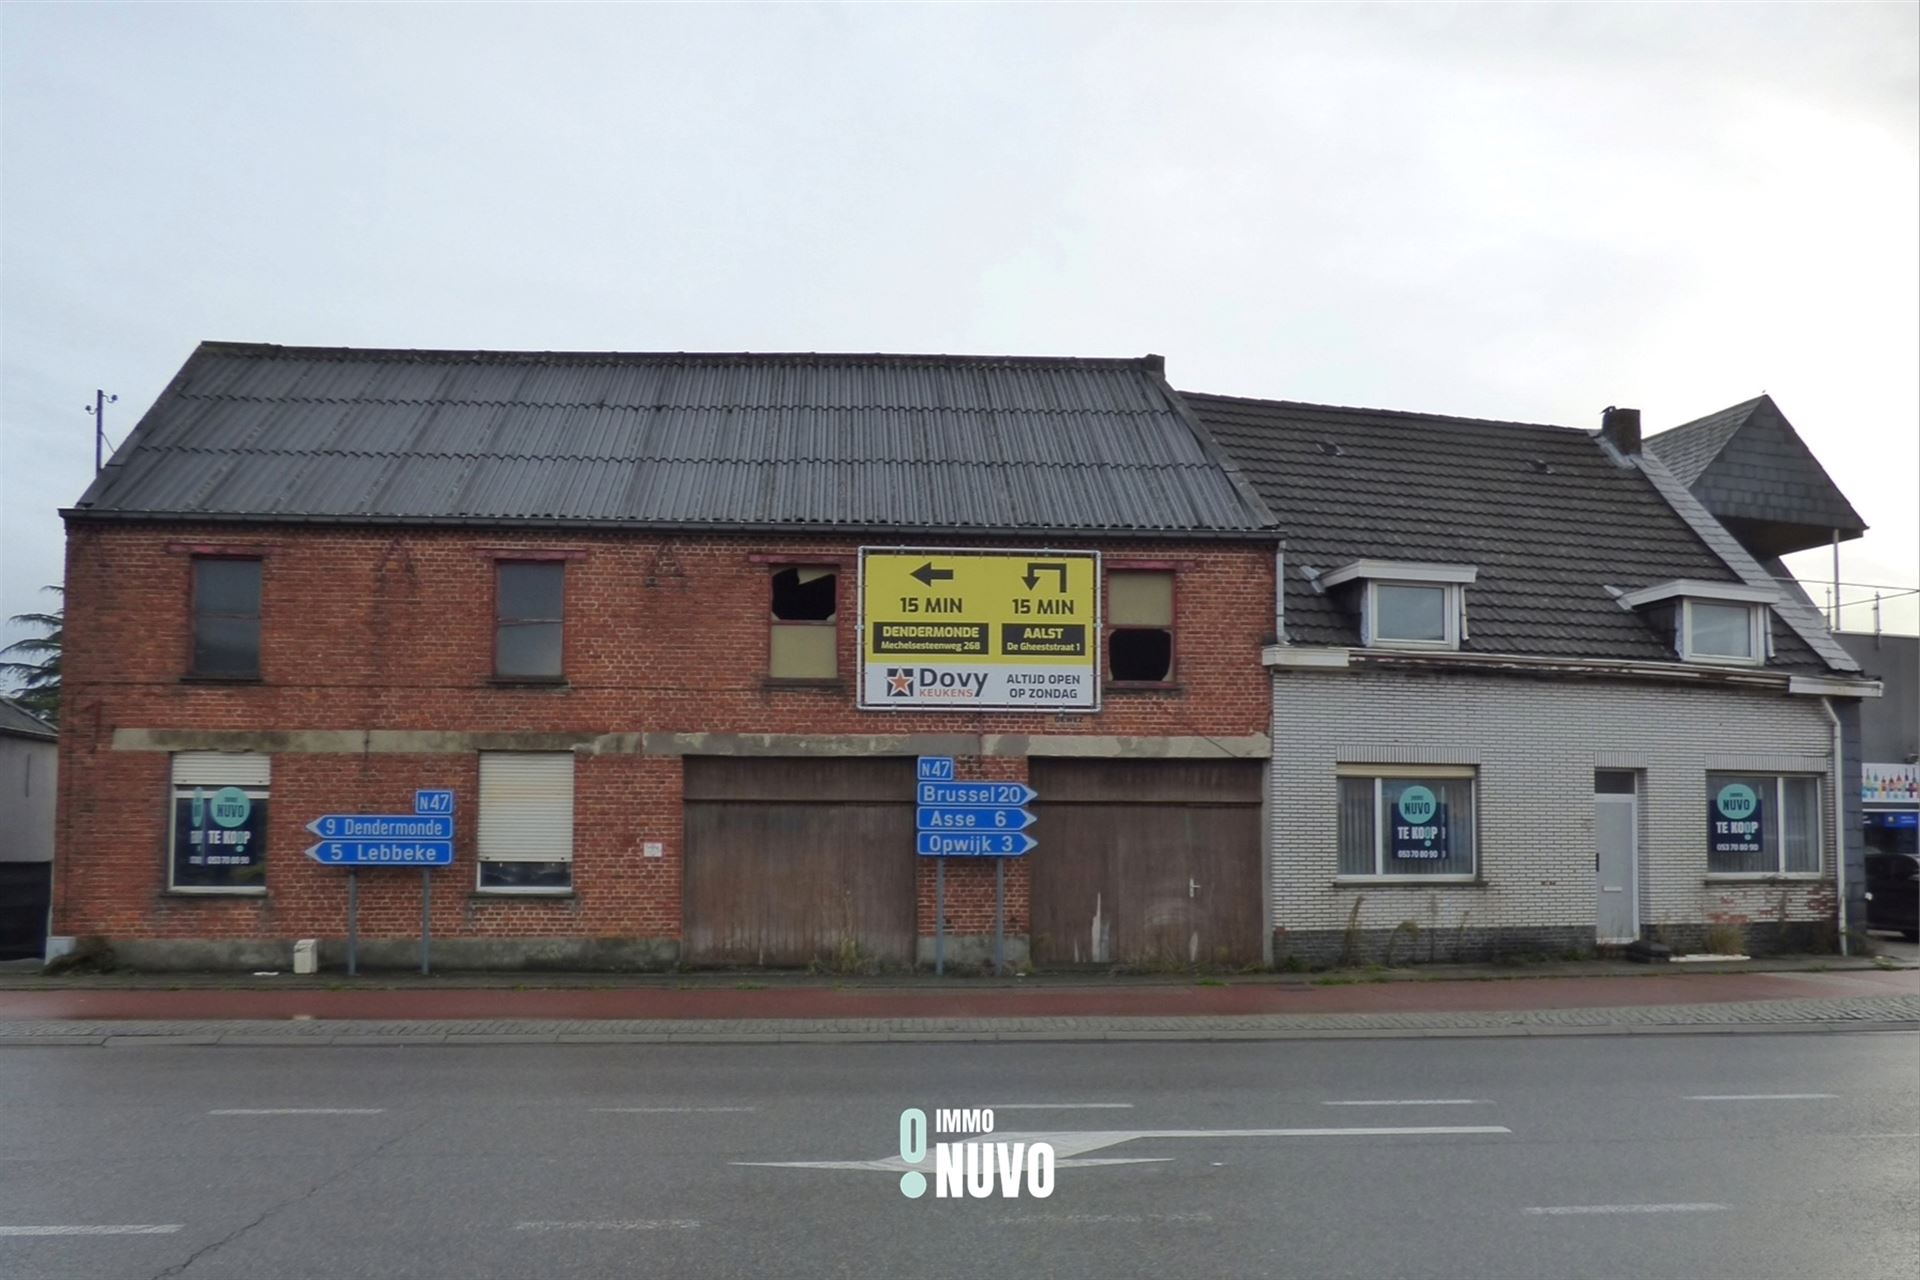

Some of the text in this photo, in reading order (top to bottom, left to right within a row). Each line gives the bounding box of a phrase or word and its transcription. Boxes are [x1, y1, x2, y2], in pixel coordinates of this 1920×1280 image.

[900, 597, 963, 613] 15 MIN
[1012, 599, 1074, 615] 15 MIN
[882, 626, 979, 638] DENDERMONDE
[1024, 628, 1064, 639] AALST
[881, 641, 980, 652] Mechelsesteenweg 268
[1007, 642, 1080, 651] De Gheeststraat 1
[919, 668, 989, 697] Dovy
[1006, 674, 1081, 685] ALTIJD OPEN
[919, 689, 973, 698] KEUKENS
[1009, 688, 1078, 699] OP ZONDAG
[921, 761, 950, 777] N47
[923, 786, 1020, 802] Brussel 20
[419, 794, 449, 810] N47
[1404, 802, 1431, 815] NUVO
[1722, 799, 1750, 811] NUVO
[216, 804, 245, 817] NUVO
[930, 811, 1007, 827] Asse 6
[325, 819, 442, 835] 9 Dendermonde
[1397, 827, 1438, 840] TE KOOP
[1715, 821, 1759, 834] TE KOOP
[207, 830, 251, 844] TE KOOP
[929, 835, 1013, 855] Opwijk 3
[331, 844, 437, 861] 5 Lebbeke
